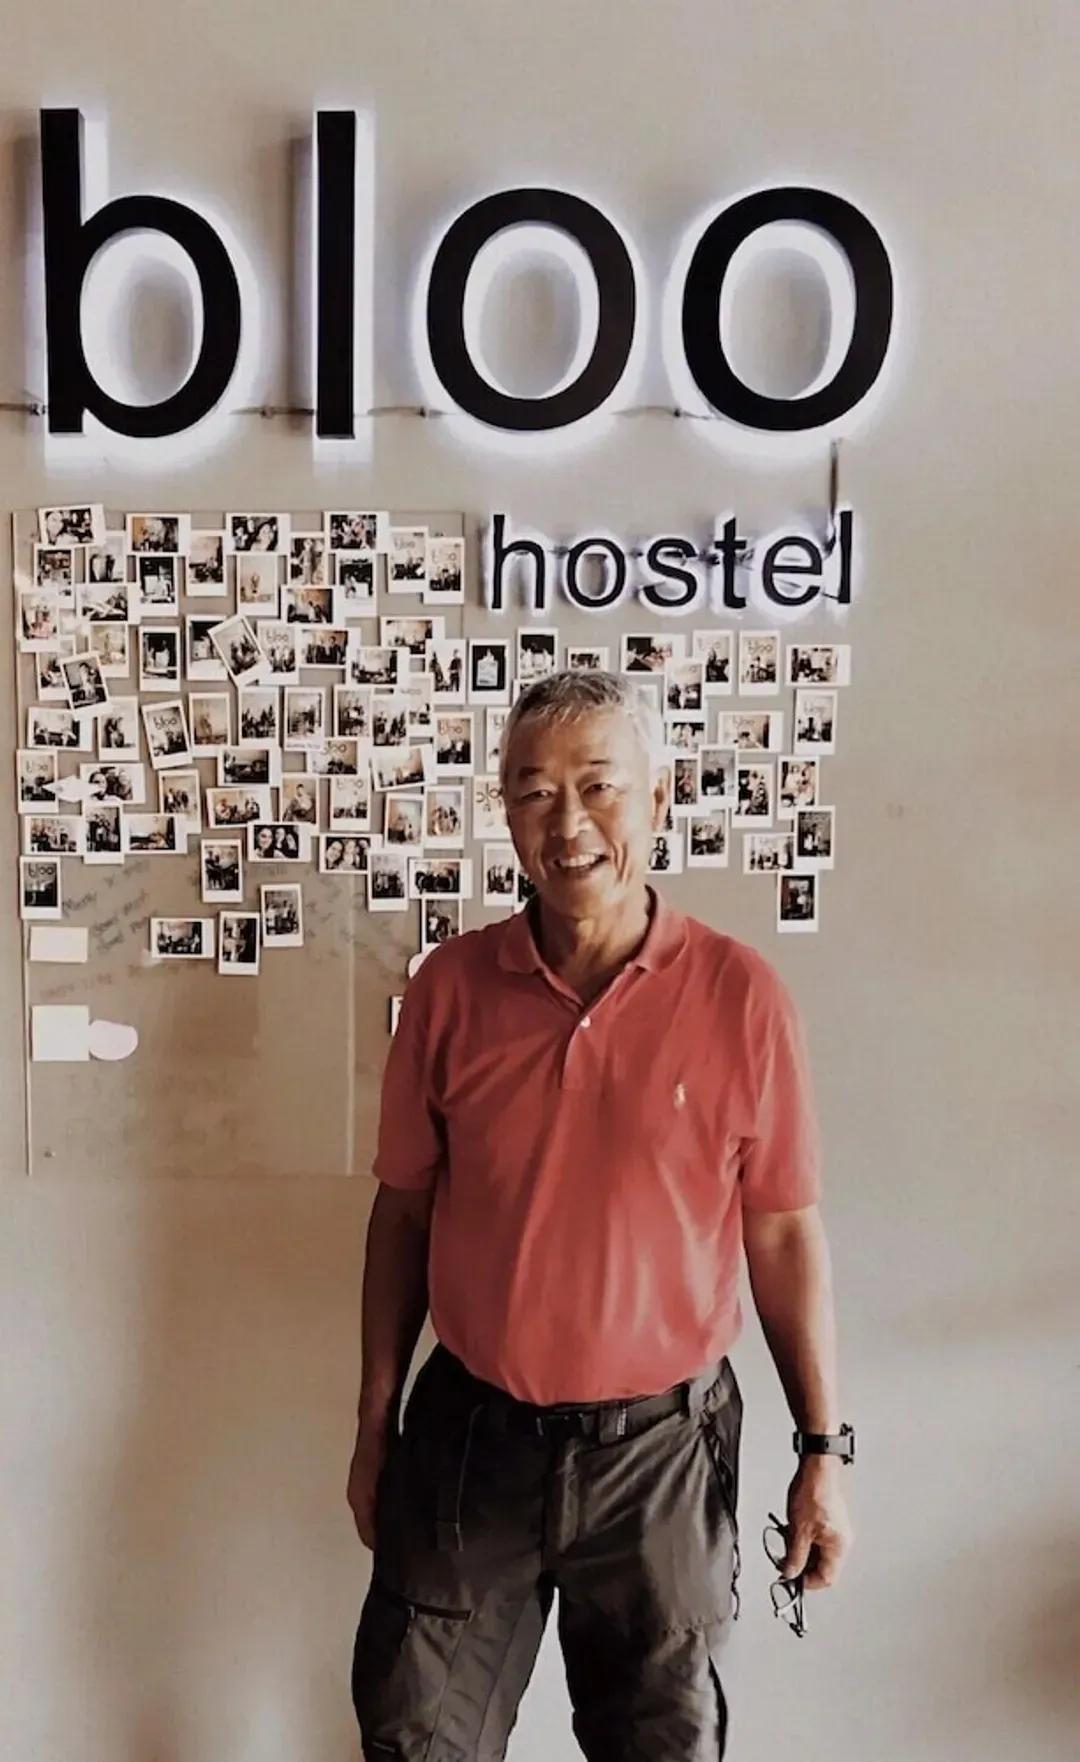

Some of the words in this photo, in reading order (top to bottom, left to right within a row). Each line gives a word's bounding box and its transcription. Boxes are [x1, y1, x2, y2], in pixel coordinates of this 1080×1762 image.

[41, 108, 893, 438] bloo
[491, 510, 853, 609] hostel
[29, 863, 55, 878] bloo
